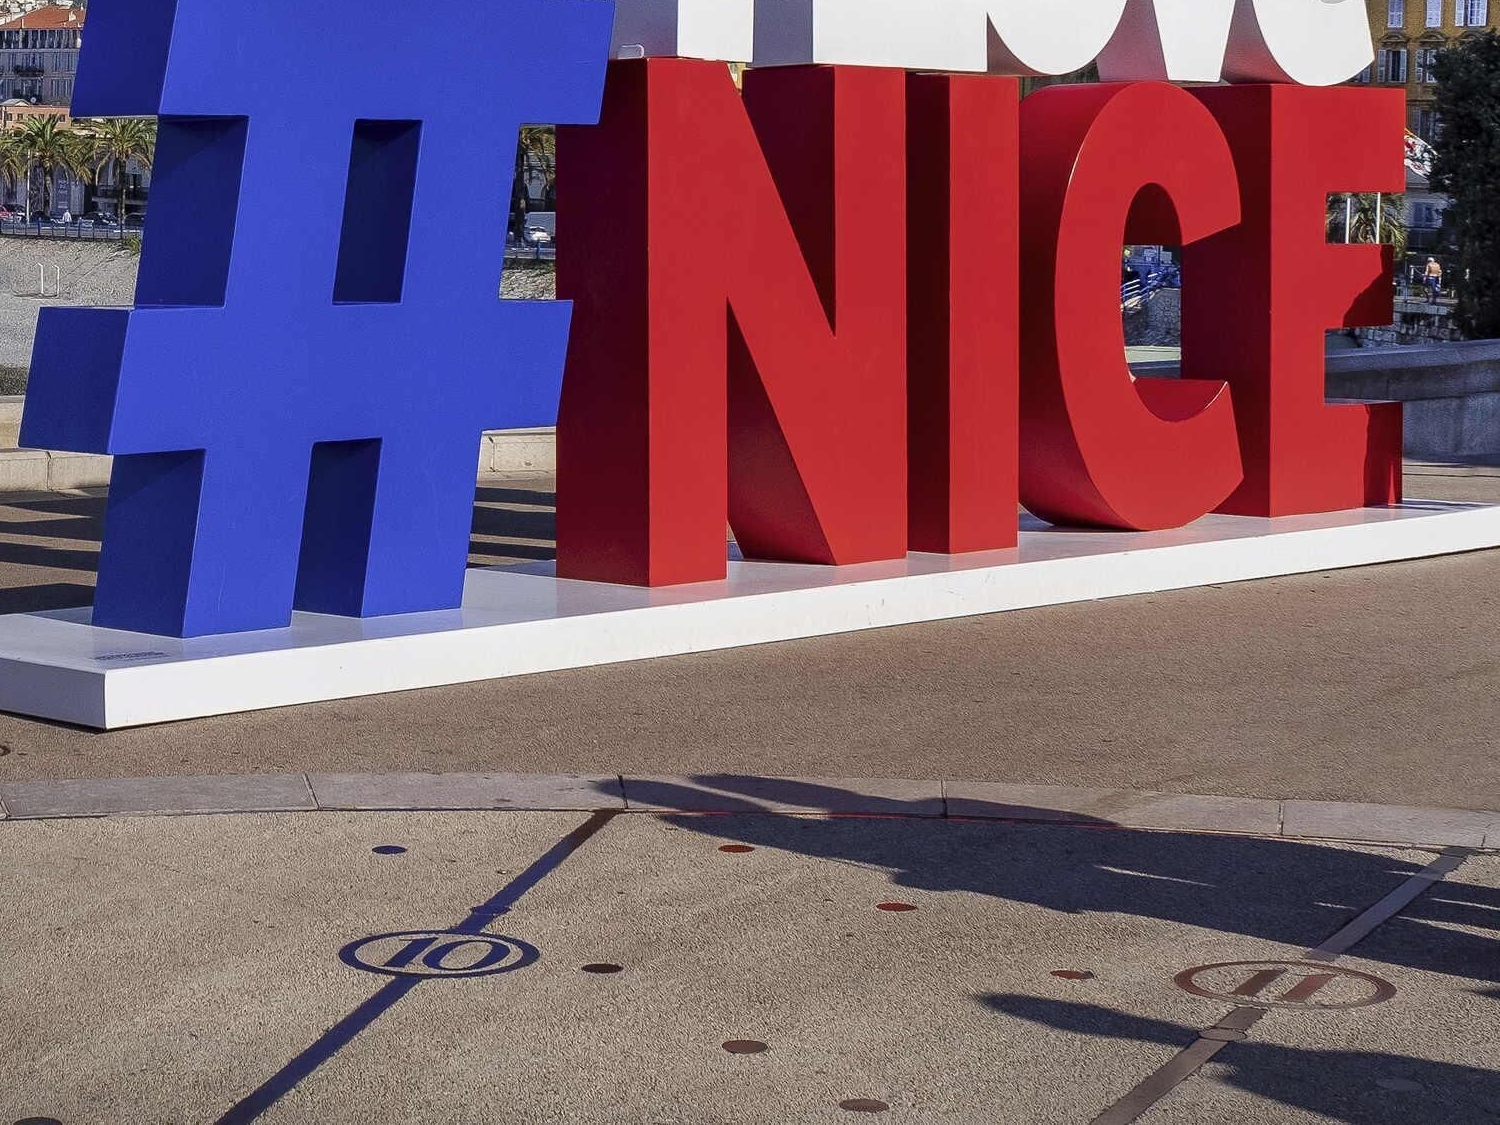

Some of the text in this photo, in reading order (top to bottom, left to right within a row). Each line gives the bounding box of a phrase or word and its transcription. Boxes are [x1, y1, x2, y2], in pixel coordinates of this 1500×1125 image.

[556, 58, 1405, 586] NICE
[382, 937, 511, 971] 10
[1229, 967, 1338, 1002] 11
